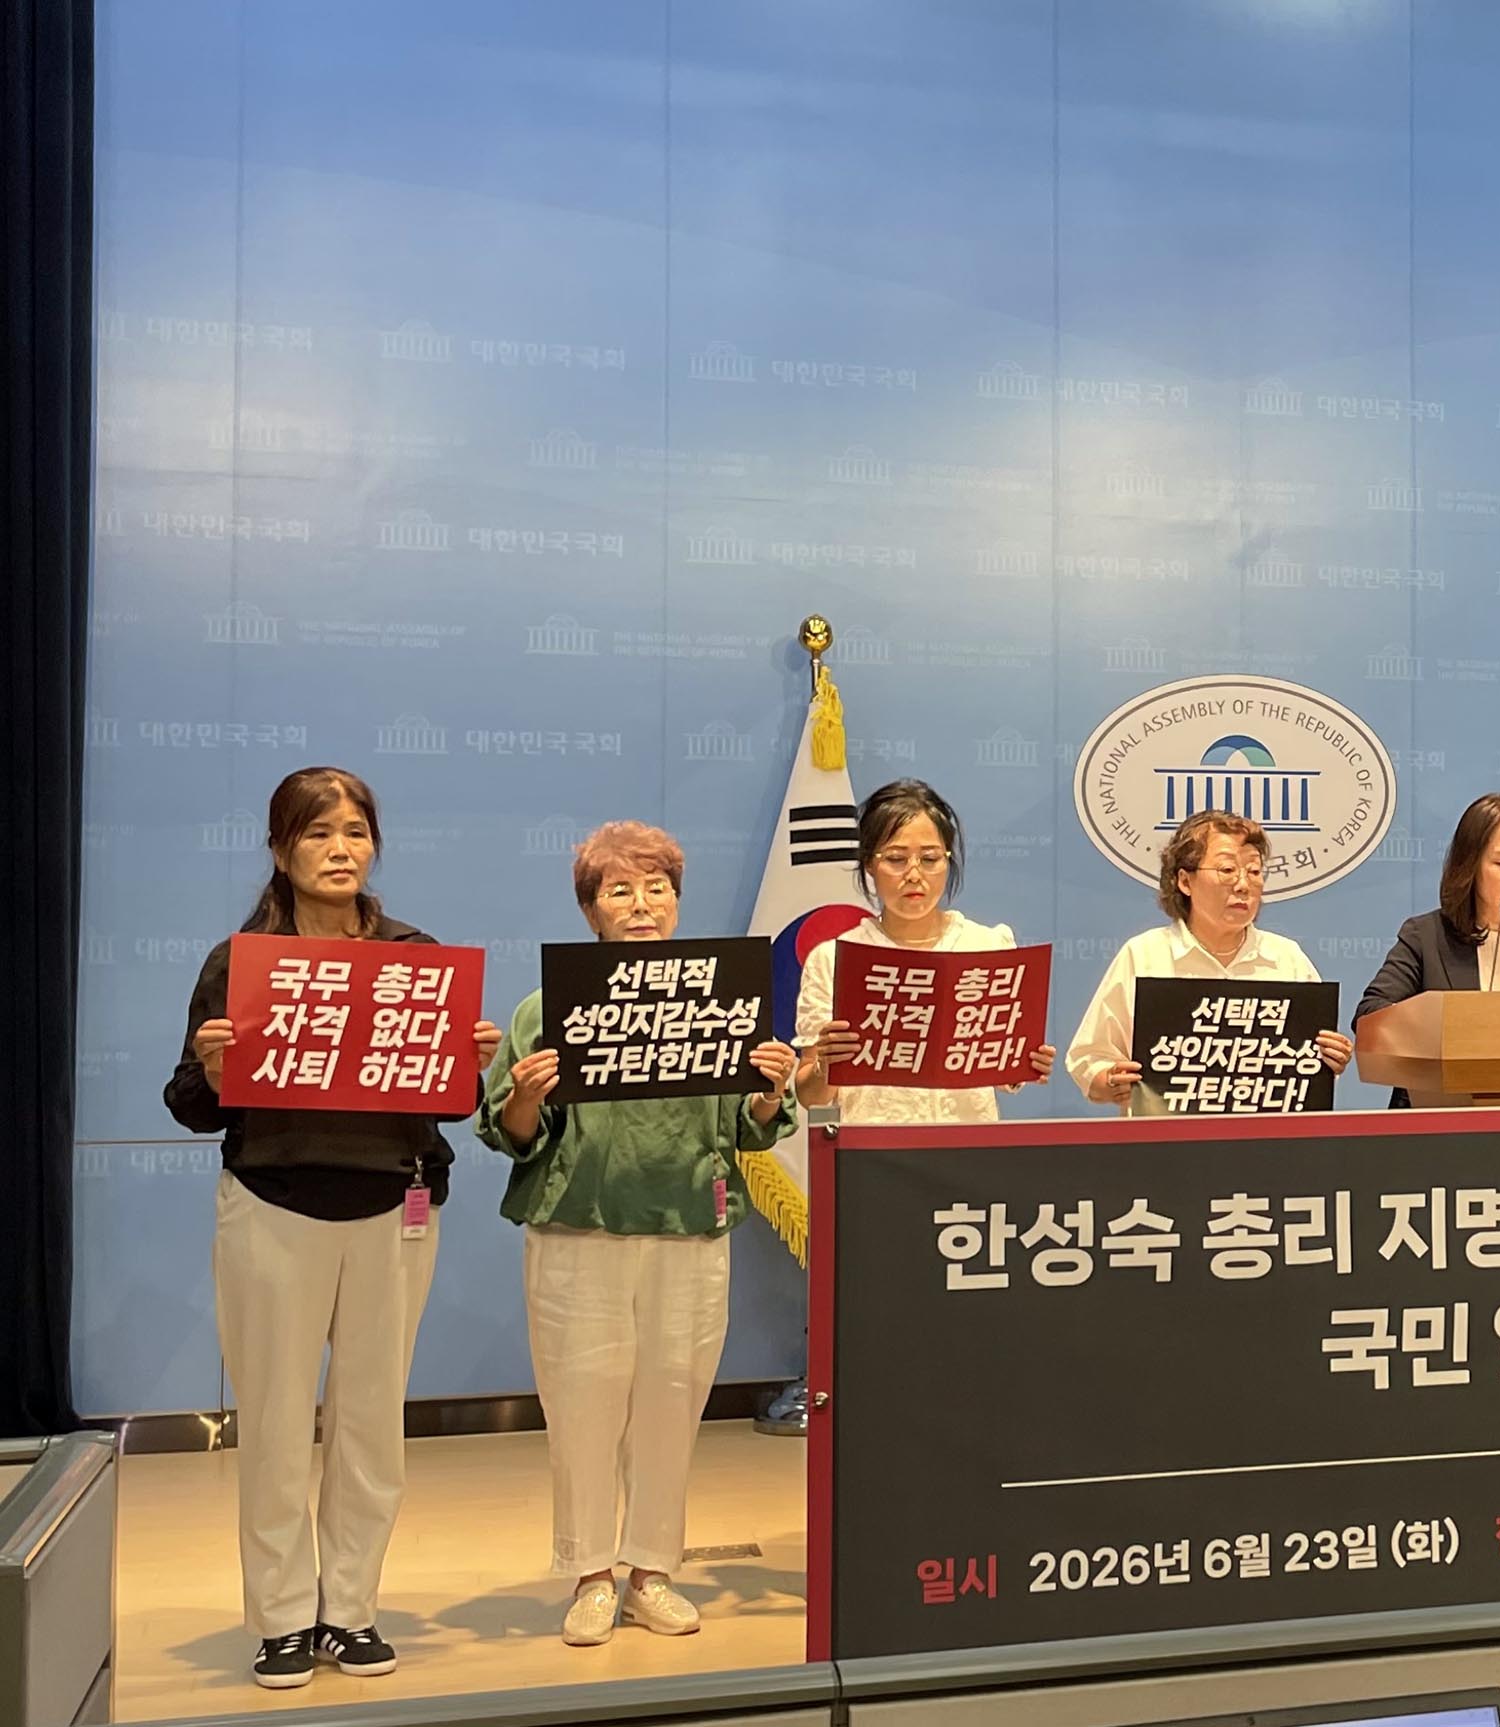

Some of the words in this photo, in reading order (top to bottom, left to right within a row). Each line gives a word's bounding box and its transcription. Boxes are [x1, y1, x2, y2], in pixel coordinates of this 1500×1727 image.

[1144, 700, 1226, 738] ASSEMBLY
[1232, 699, 1254, 715] OF
[1260, 701, 1290, 722] THE
[1295, 711, 1363, 766] REPUBLIC
[1099, 734, 1141, 815] NATIONAL
[1356, 769, 1373, 792] OF
[1112, 819, 1141, 847] THE
[1332, 797, 1372, 846] KOREA
[269, 958, 352, 1000] 국무
[372, 963, 454, 1007] 총리
[607, 957, 718, 1000] 선택적
[864, 964, 936, 1001] 국무
[954, 964, 1026, 1002] 총리
[263, 1003, 350, 1046] 자격
[369, 1008, 450, 1050] 없다
[563, 997, 761, 1045] 성인지감수성
[860, 1003, 936, 1038] 자격
[953, 1001, 1022, 1039] 없다
[1191, 997, 1291, 1036] 선택적
[251, 1048, 340, 1090] 사퇴
[358, 1052, 455, 1094] 하라!
[580, 1040, 743, 1085] 규탄한다!
[852, 1039, 928, 1074] 사퇴
[944, 1037, 1027, 1075] 하라!
[1150, 1035, 1322, 1075] 성인지감수성
[1163, 1076, 1310, 1113] 규탄한다!
[933, 1198, 1182, 1291] 한성숙
[1202, 1190, 1353, 1280] 총리
[1320, 1302, 1470, 1390] 국민
[917, 1554, 999, 1604] 일시
[1028, 1538, 1191, 1593] 2026년
[1203, 1533, 1273, 1578] 6월
[1283, 1525, 1379, 1573] 23일
[1390, 1517, 1462, 1569] (화)
